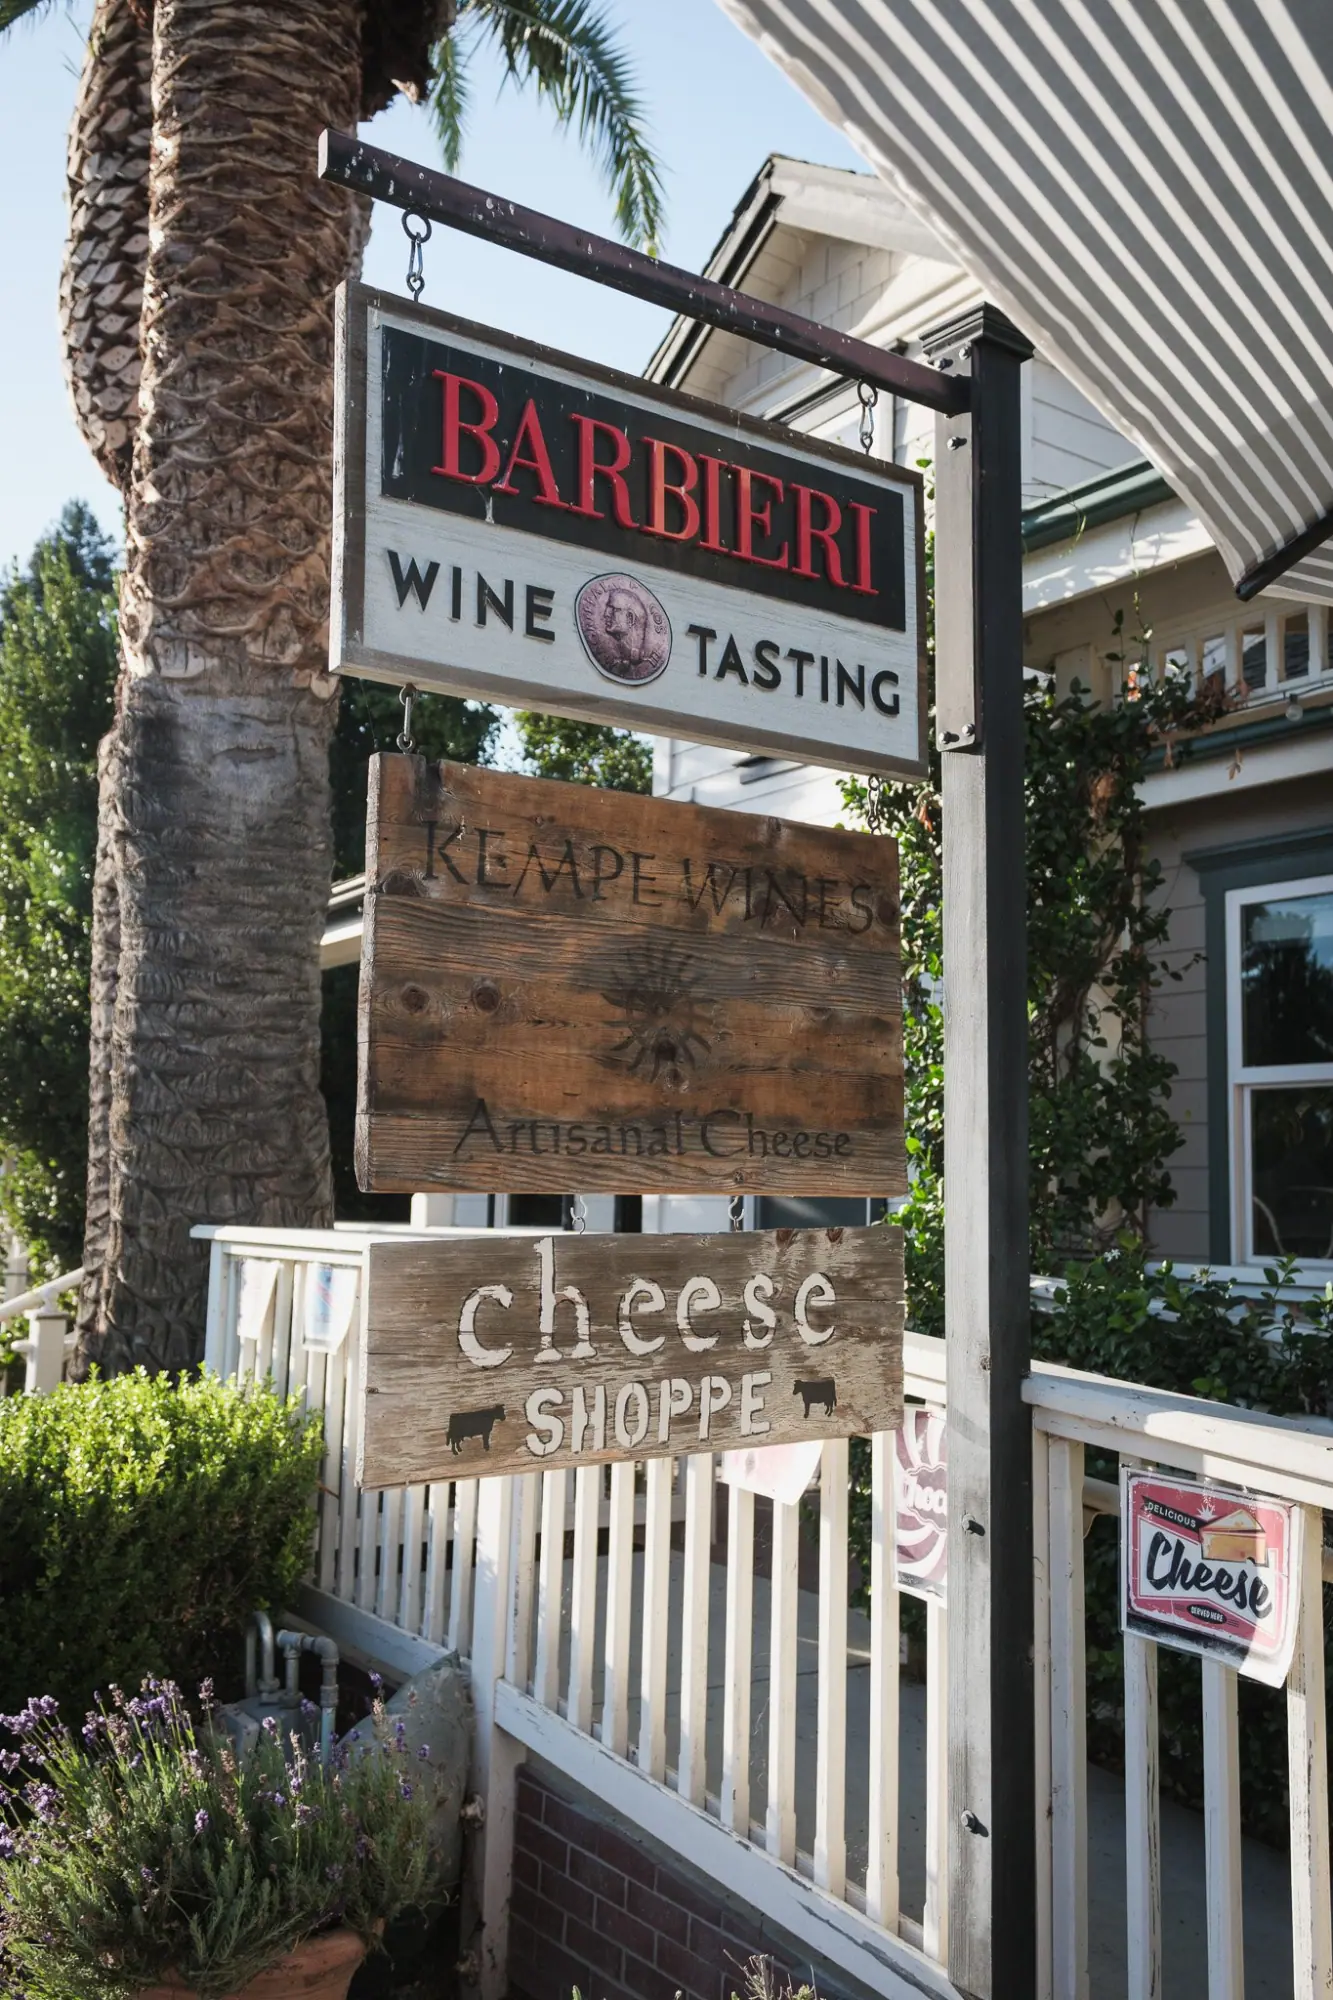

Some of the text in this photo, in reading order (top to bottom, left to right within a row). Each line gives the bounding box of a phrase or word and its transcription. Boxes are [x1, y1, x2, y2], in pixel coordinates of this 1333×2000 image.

[430, 368, 880, 597] BARBIERI
[387, 549, 557, 643] WINE
[686, 624, 901, 717] TASTING
[420, 820, 874, 935] KEMPE WINES
[453, 1097, 853, 1159] Artisanal Cheese
[456, 1236, 837, 1369] cheese
[523, 1370, 773, 1458] SHOPPE
[1147, 1502, 1197, 1529] DELICIOUS
[1146, 1531, 1272, 1619] Cheese
[1190, 1605, 1224, 1622] SERVED HERE
